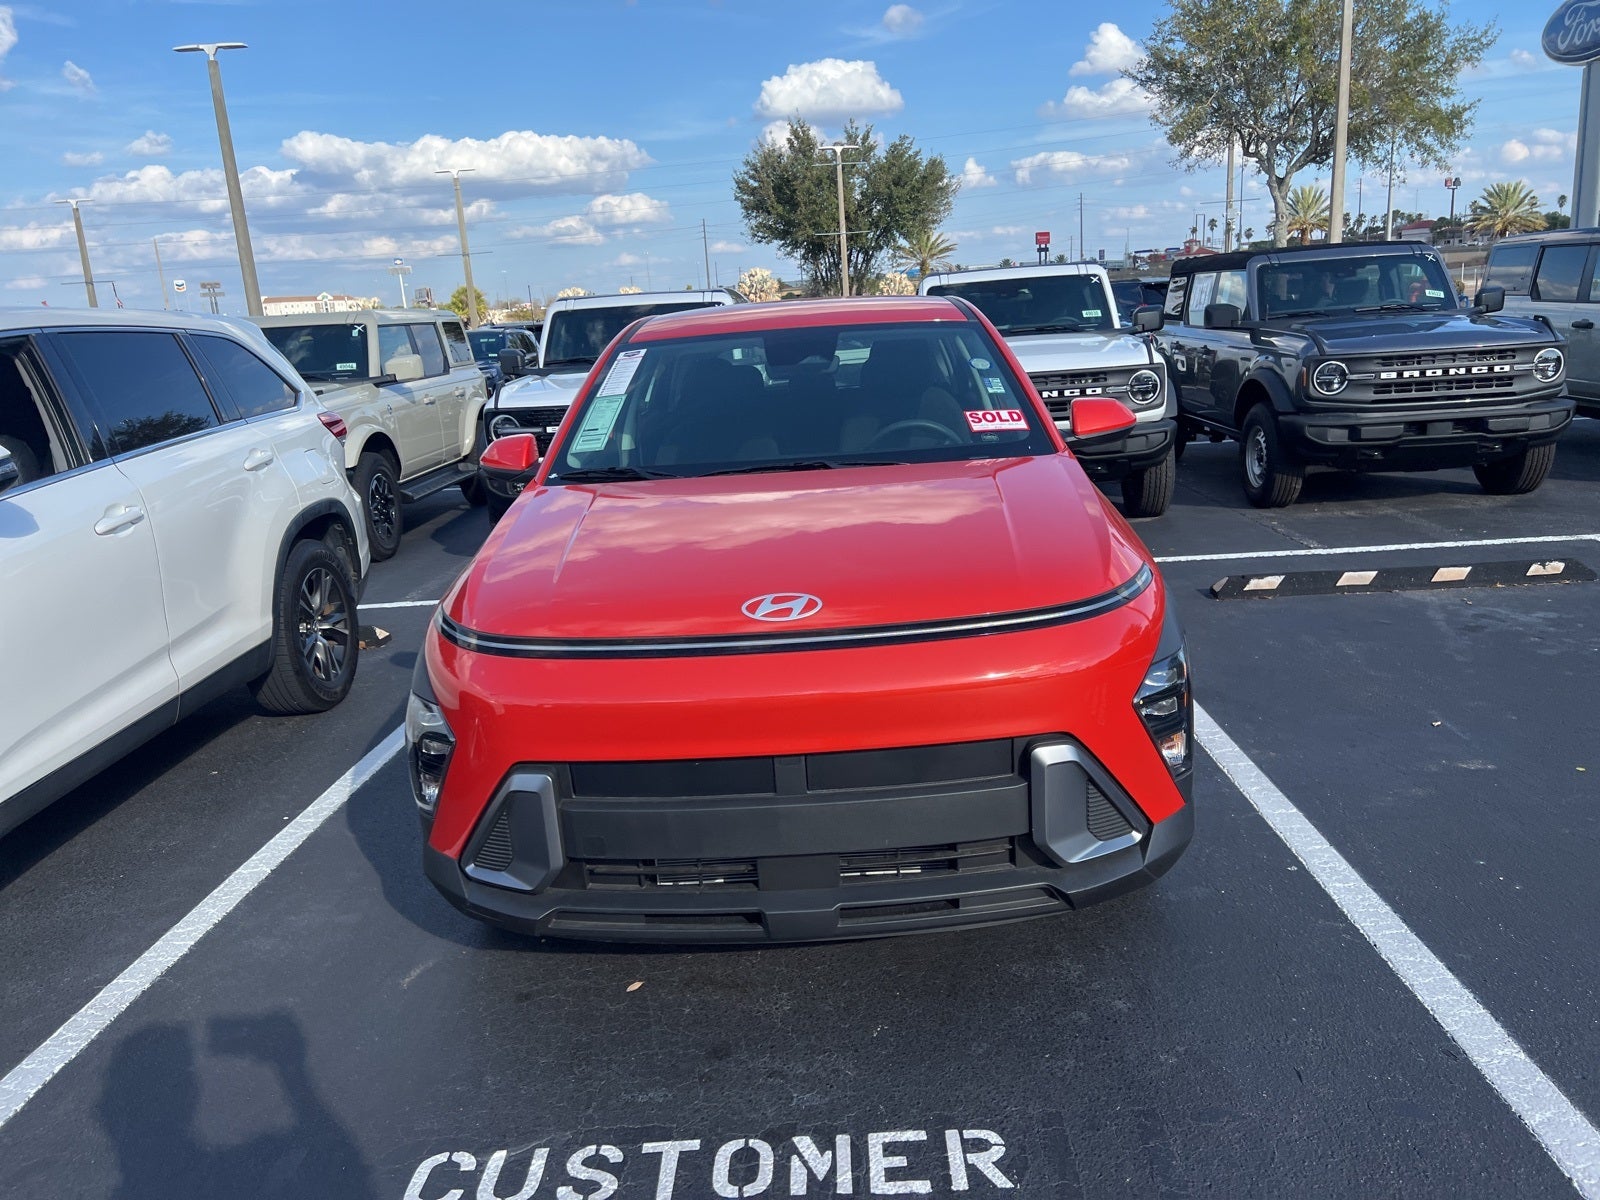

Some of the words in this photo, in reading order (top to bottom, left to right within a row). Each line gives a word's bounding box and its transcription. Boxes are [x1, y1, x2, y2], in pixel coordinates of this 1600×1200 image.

[1557, 0, 1600, 50] For
[1380, 364, 1510, 379] BRONCO
[1042, 387, 1102, 398] NCO
[968, 411, 1022, 424] SOLD
[402, 1129, 1017, 1200] CUSTOMER
